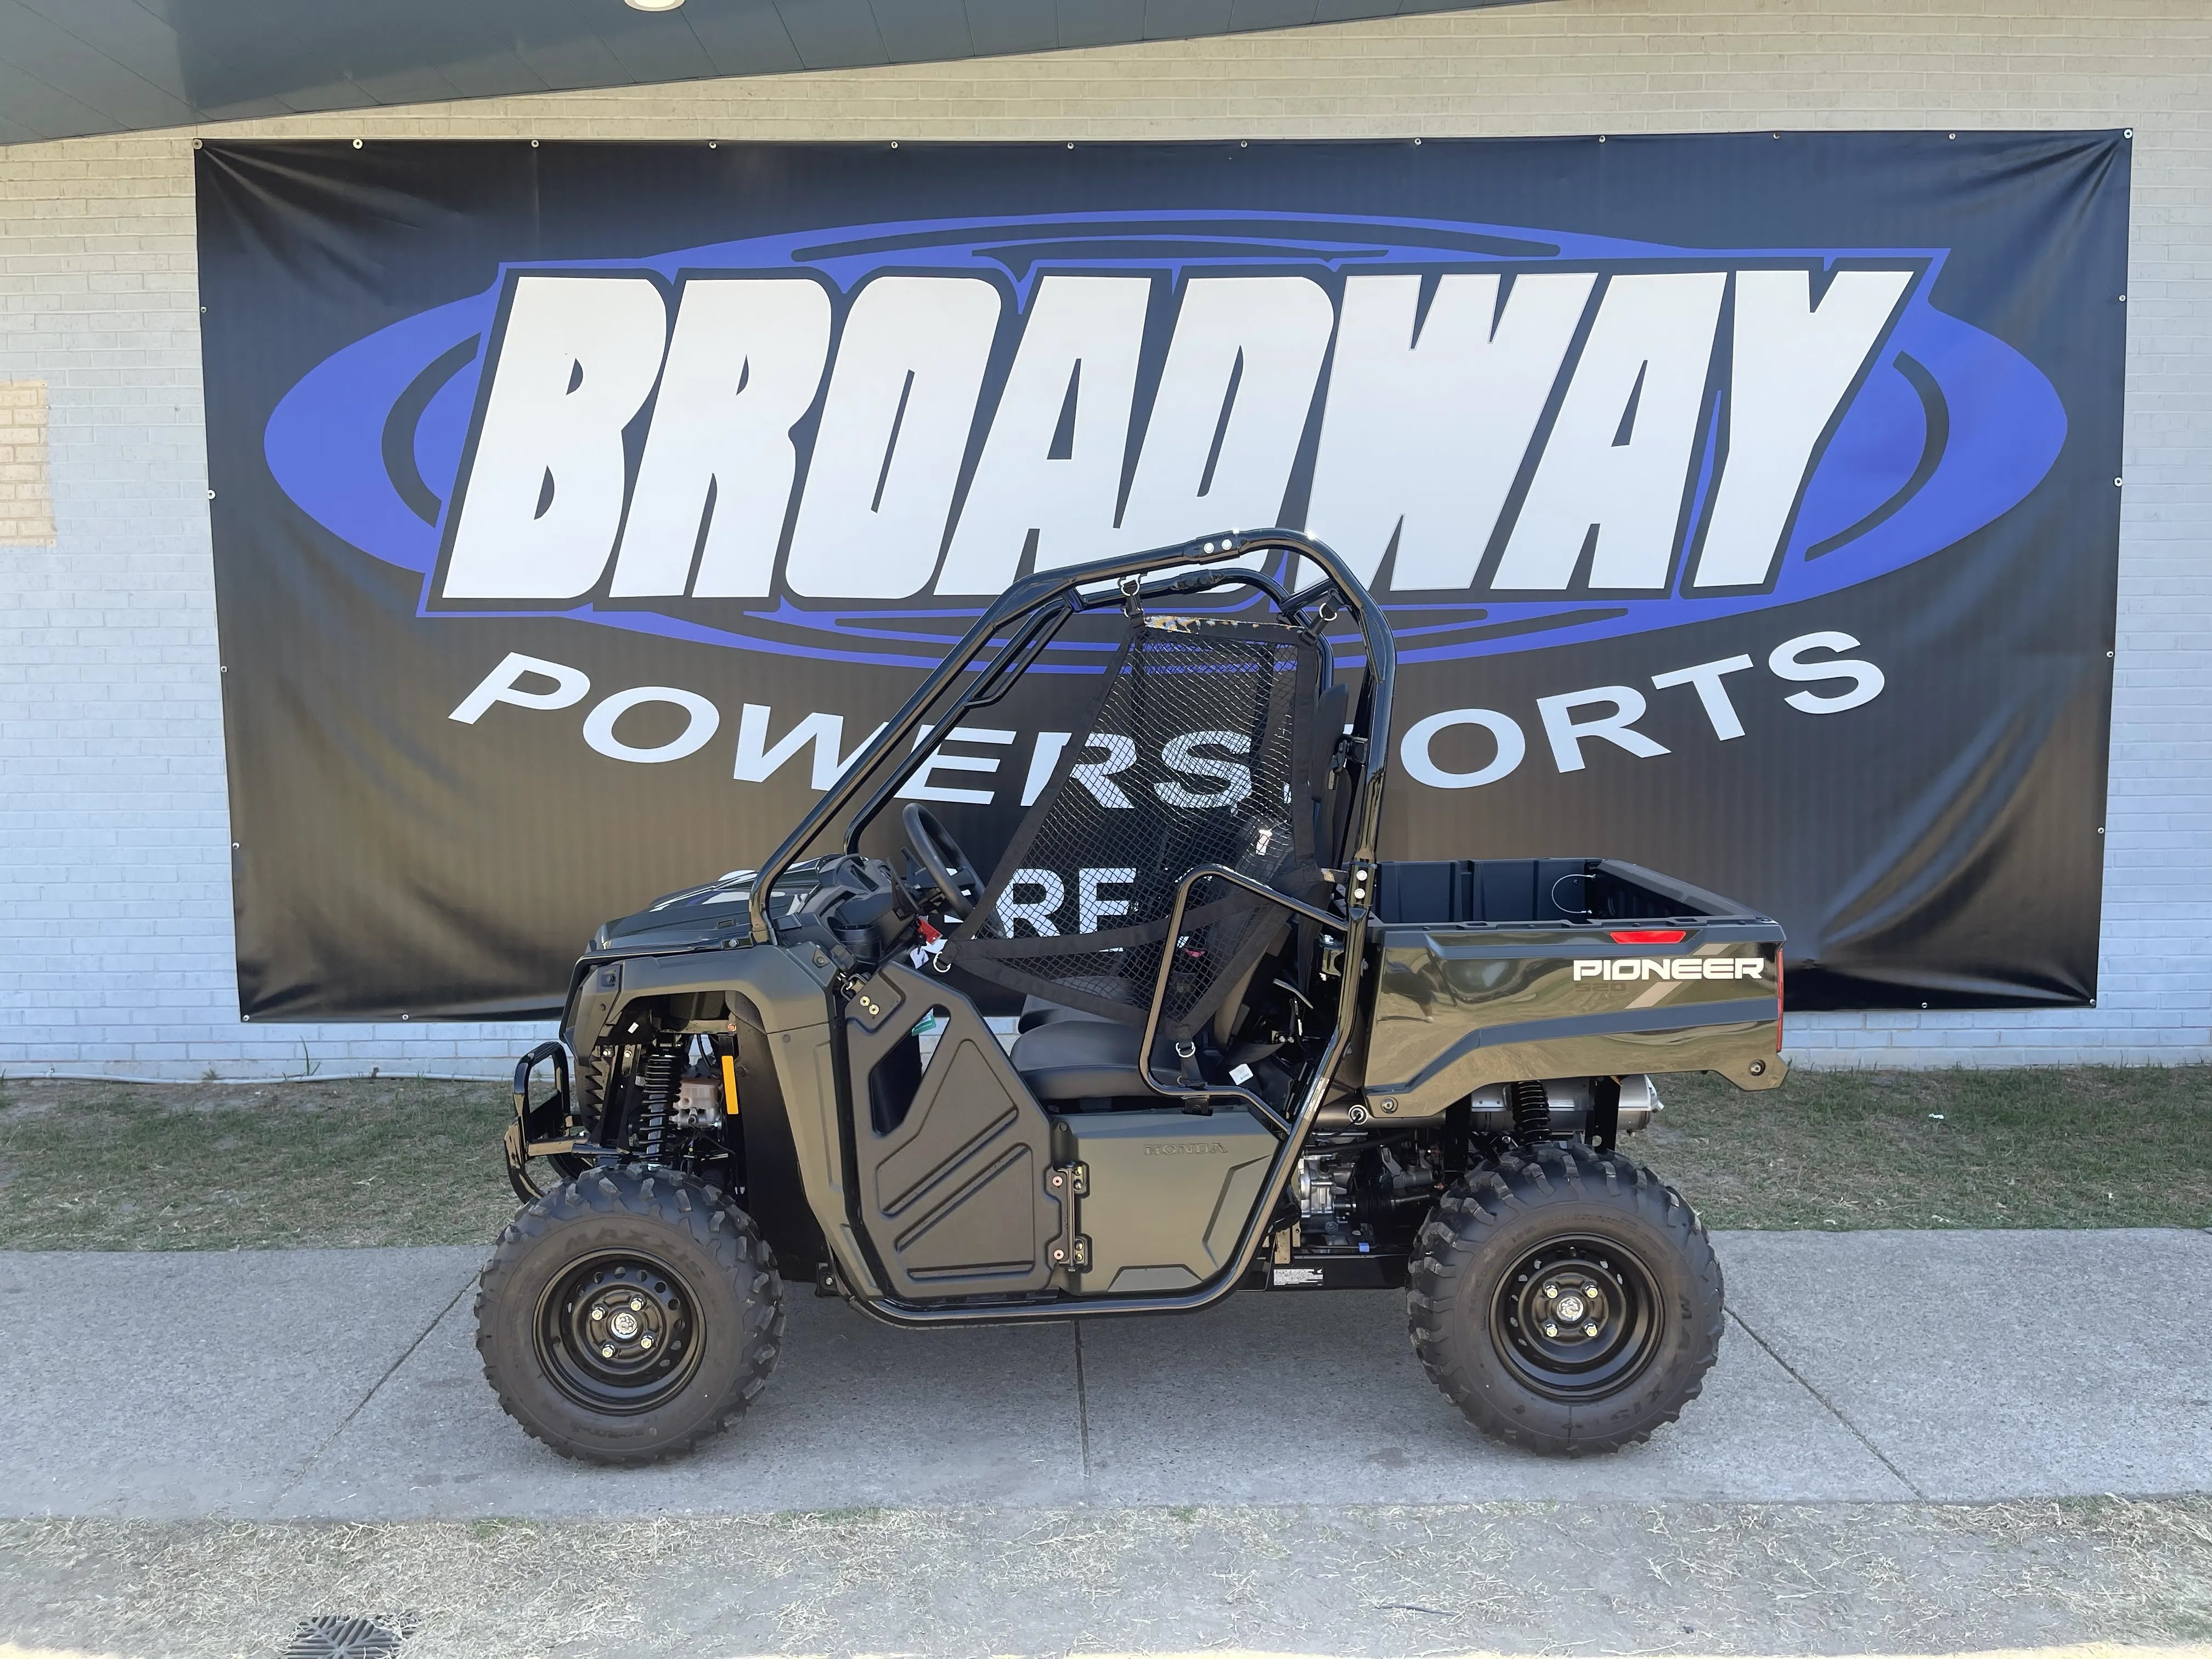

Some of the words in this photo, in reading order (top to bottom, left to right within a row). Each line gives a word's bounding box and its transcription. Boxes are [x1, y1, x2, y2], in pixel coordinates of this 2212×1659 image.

[442, 270, 1914, 599] BROADWAY
[448, 631, 1885, 810] POWERSORTS
[1573, 957, 1764, 981] PIONEER
[1144, 1142, 1228, 1155] HONDA
